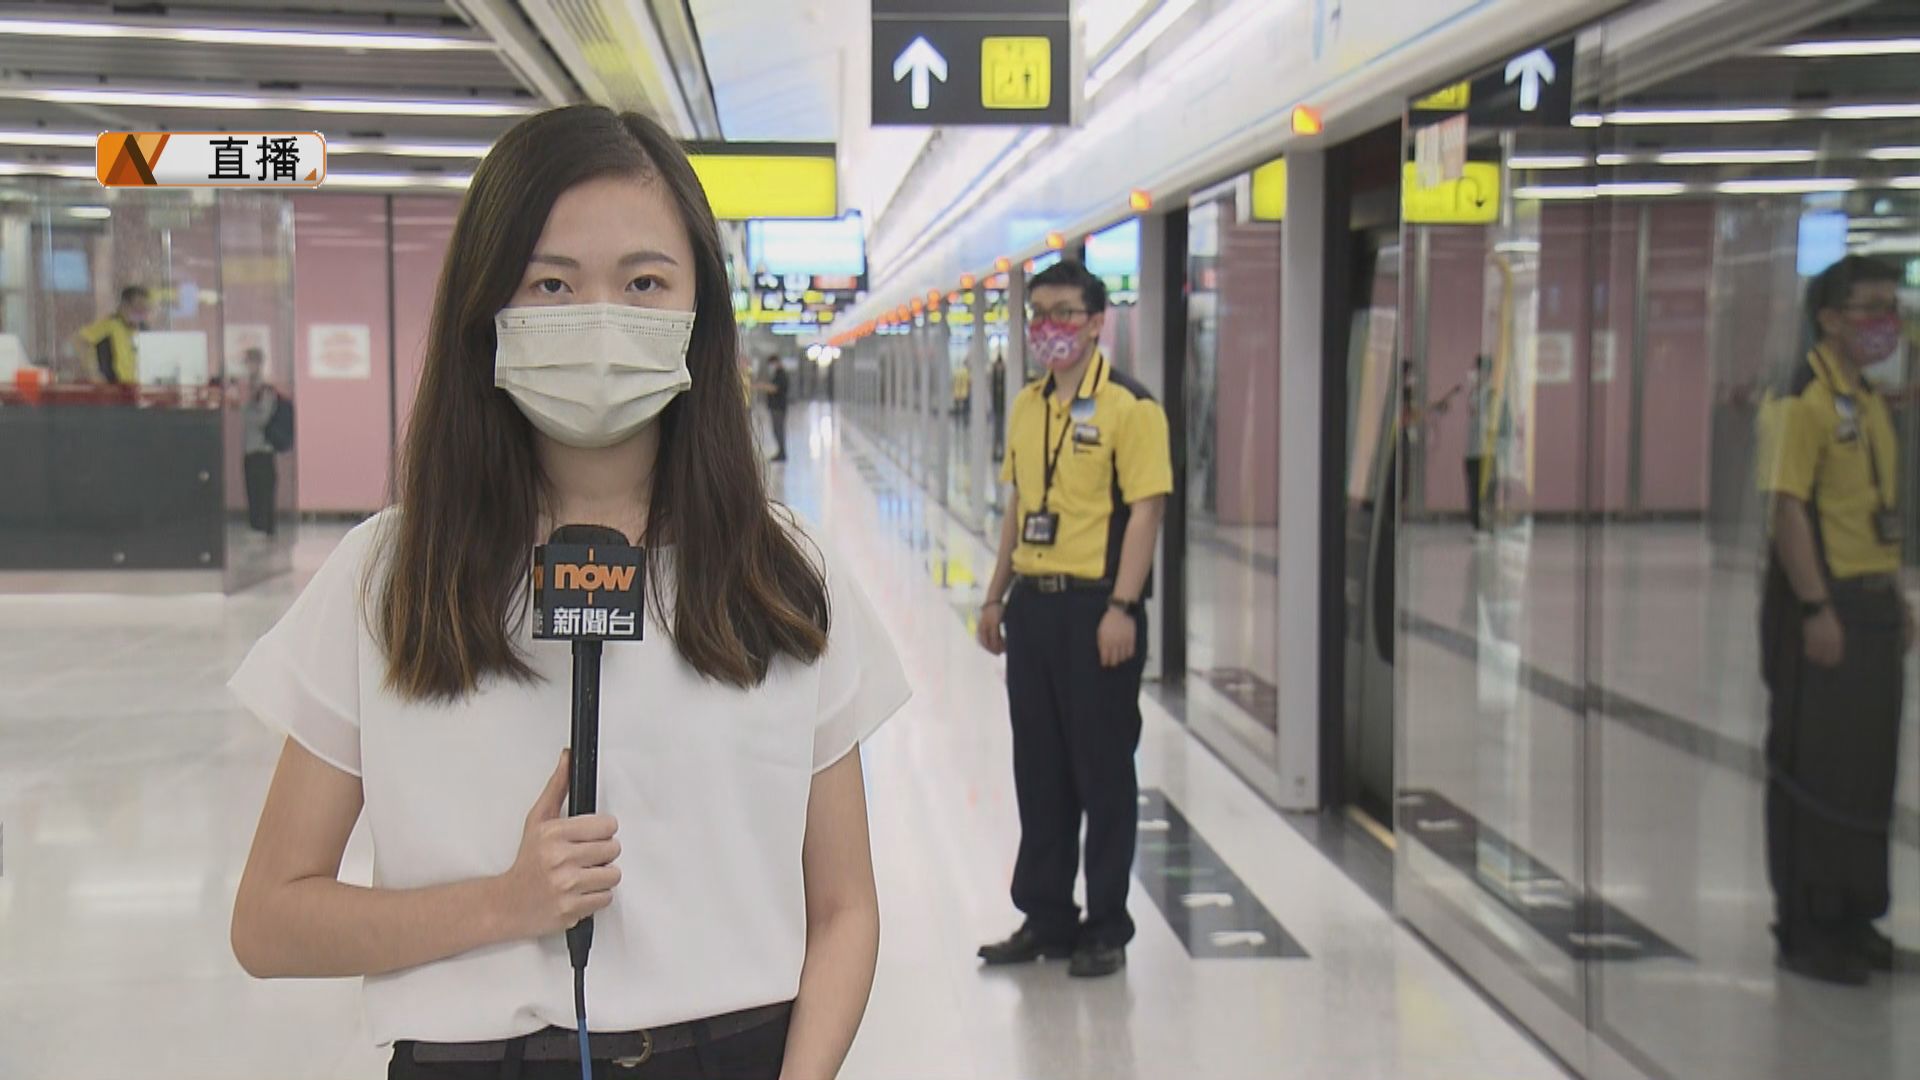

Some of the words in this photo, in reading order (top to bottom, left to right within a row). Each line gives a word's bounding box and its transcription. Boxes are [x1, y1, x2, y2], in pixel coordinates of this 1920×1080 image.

[554, 563, 637, 592] now
[552, 606, 636, 636] 新聞台
